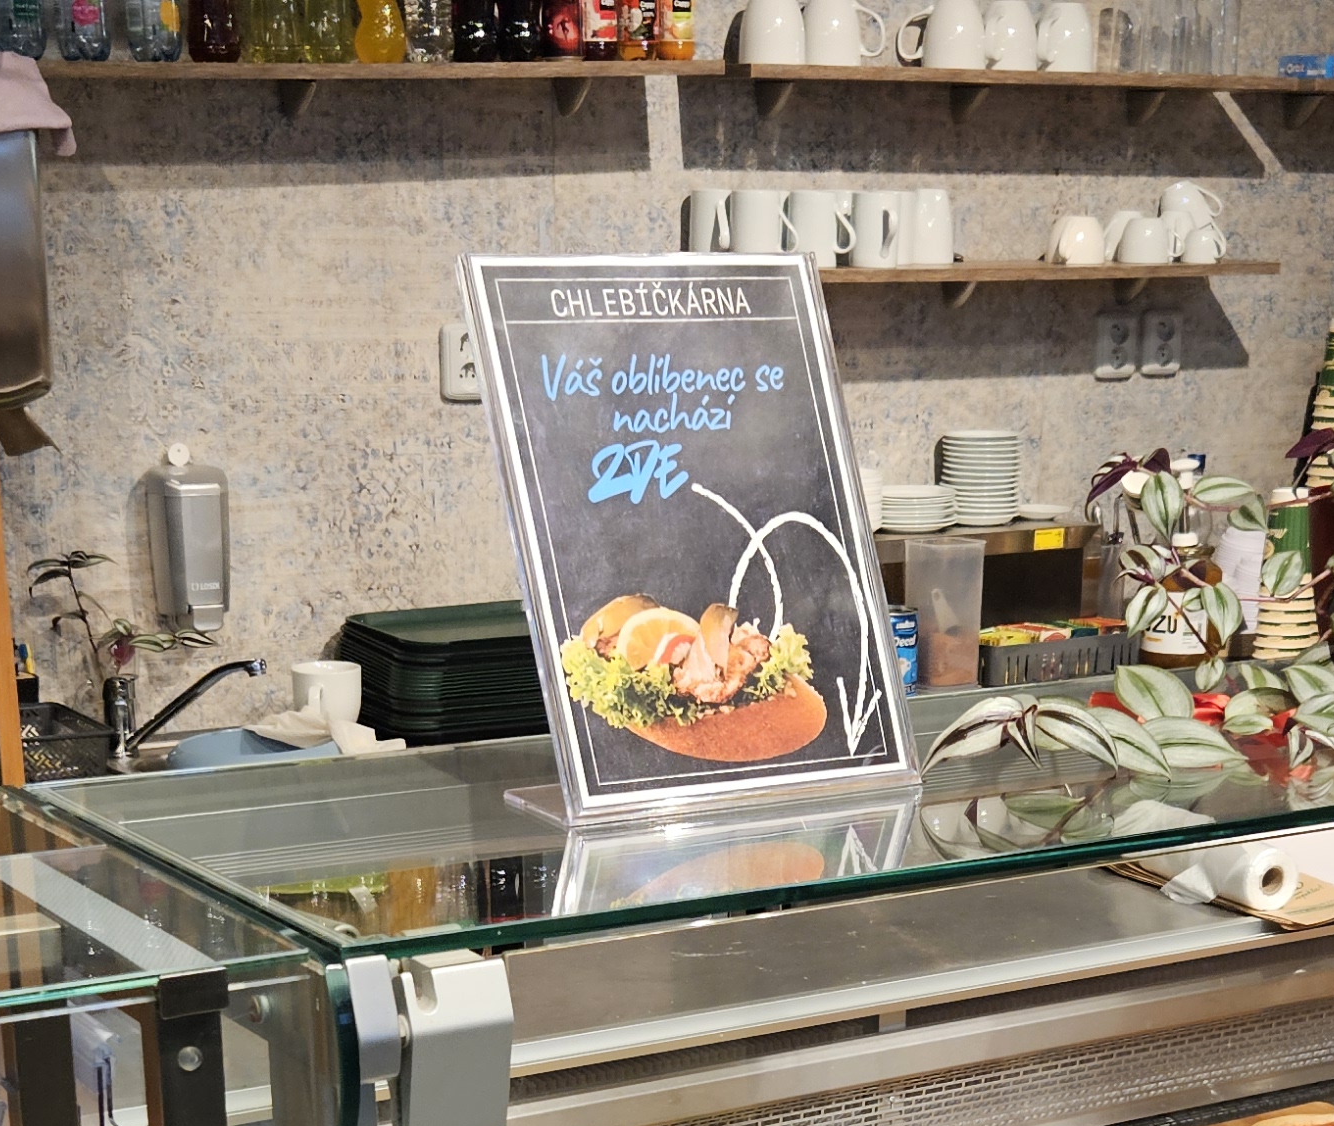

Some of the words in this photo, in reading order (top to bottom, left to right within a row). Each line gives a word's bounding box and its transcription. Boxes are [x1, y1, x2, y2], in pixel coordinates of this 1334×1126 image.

[550, 280, 753, 319] CHLEBÍČKÁRNA
[541, 354, 603, 402] Váš
[612, 354, 747, 396] oblíbenec
[755, 363, 785, 392] se
[613, 392, 735, 434] nachází
[587, 439, 689, 504] ZDE
